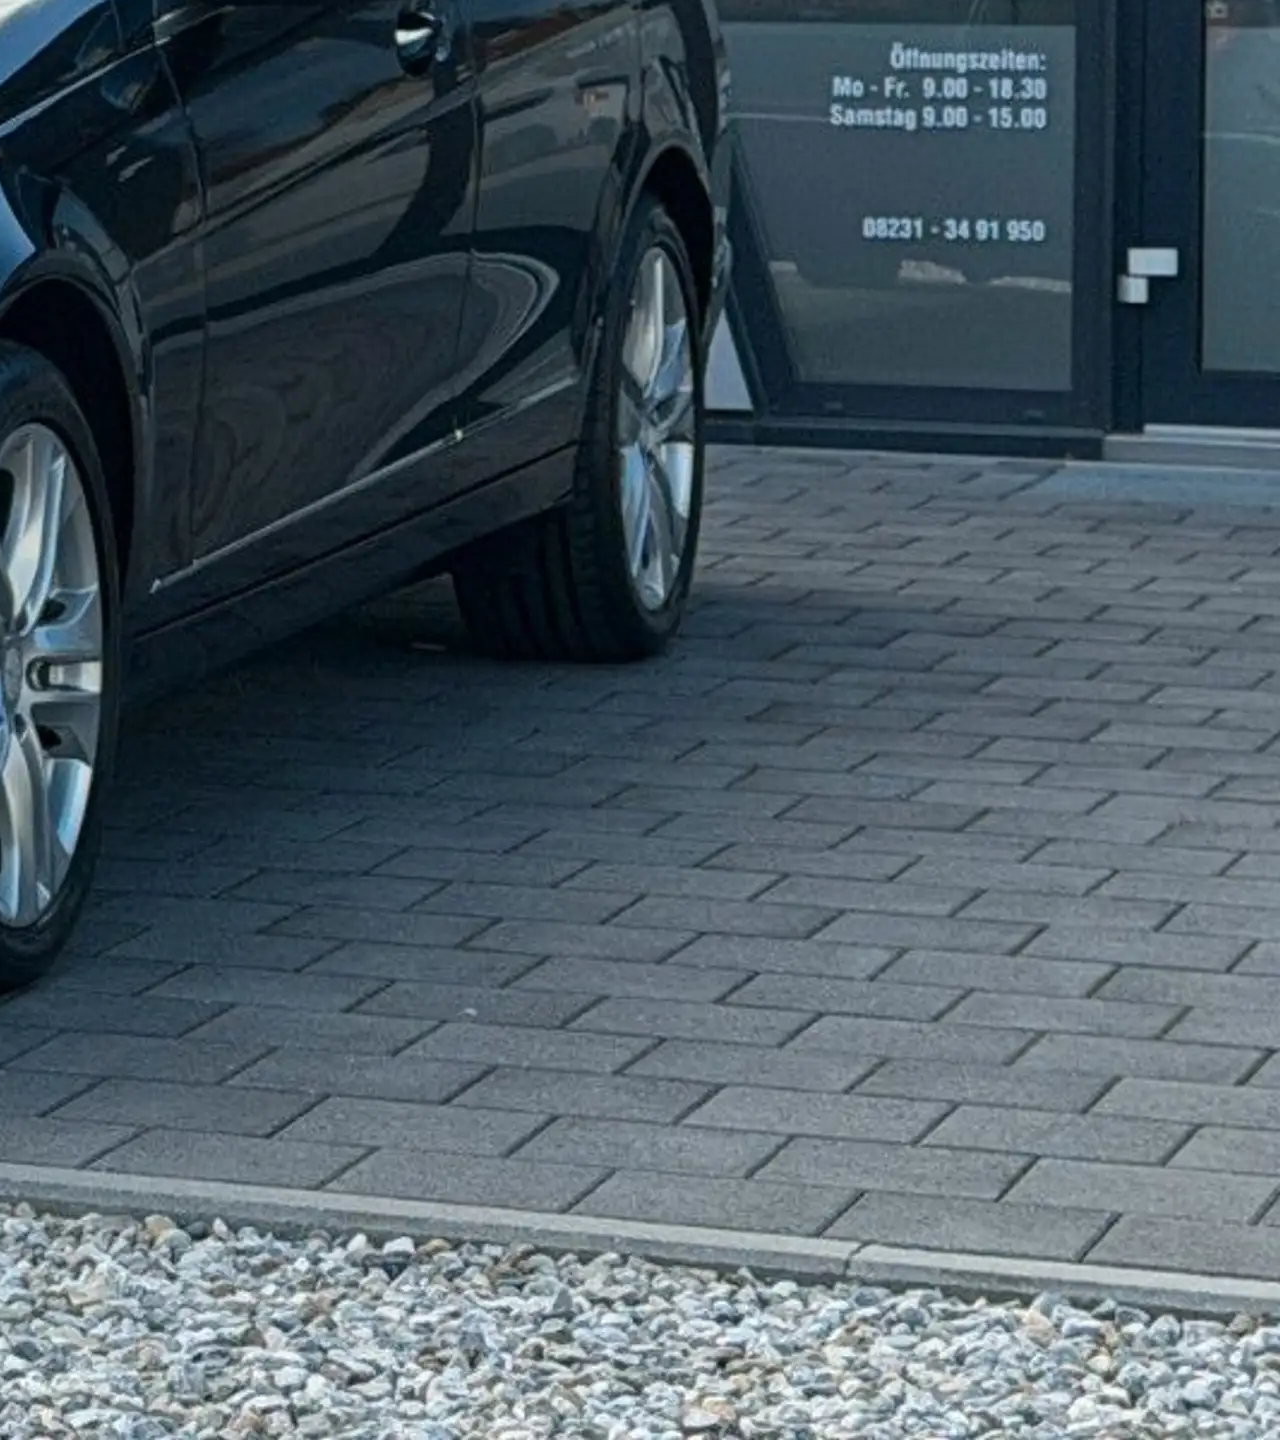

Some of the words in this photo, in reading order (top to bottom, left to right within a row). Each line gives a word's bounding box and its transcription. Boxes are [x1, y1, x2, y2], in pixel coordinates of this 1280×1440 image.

[890, 42, 1047, 74] Öffnungszeiten:
[832, 76, 865, 98] Mo
[883, 76, 911, 98] Fr.
[922, 77, 969, 99] 9.00
[989, 77, 1048, 100] 18.30
[829, 103, 918, 131] Samstag
[922, 105, 969, 128] 9.00
[988, 107, 1048, 129] 15.00
[862, 216, 924, 240] 08231
[943, 218, 971, 241] 34
[975, 218, 1001, 241] 91
[1006, 219, 1047, 242] 950
